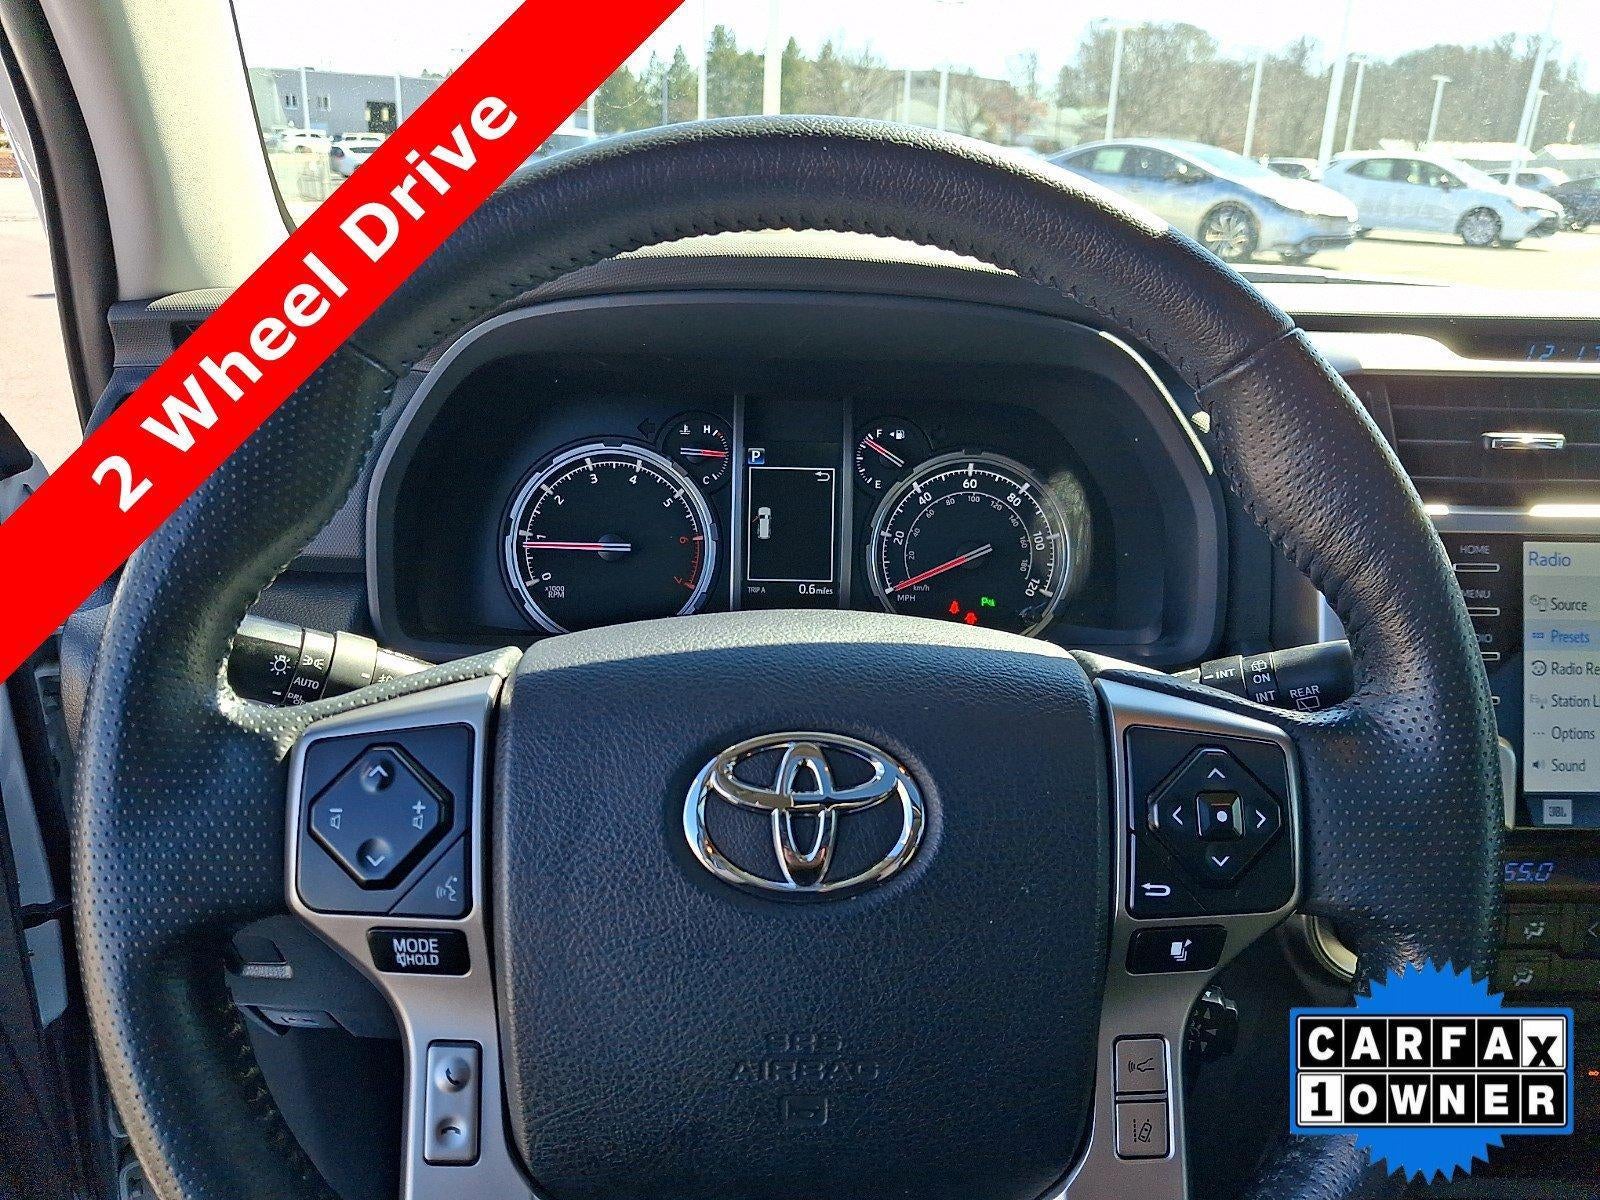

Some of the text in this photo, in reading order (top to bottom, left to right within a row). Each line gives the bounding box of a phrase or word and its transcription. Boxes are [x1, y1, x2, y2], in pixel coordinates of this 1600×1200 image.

[703, 424, 711, 434] H
[876, 429, 883, 438] F
[590, 474, 598, 484] 3
[628, 475, 637, 485] 4
[702, 475, 710, 485] C
[875, 480, 882, 489] E
[962, 478, 978, 489] 60
[554, 495, 565, 506] 2
[663, 498, 673, 508] 5
[918, 491, 933, 506] 40
[967, 494, 981, 504] 100
[1006, 492, 1022, 508] 80
[990, 500, 1003, 511] 120
[893, 530, 905, 546] 20
[912, 527, 921, 538] 40
[1033, 530, 1045, 551] 100
[908, 550, 915, 560] 20
[1459, 544, 1490, 555] HOME
[1528, 550, 1572, 567] Radio
[541, 572, 552, 581] 0
[913, 584, 930, 592] km/h
[1025, 578, 1041, 598] 120
[897, 594, 916, 602] MPH
[1550, 597, 1587, 612] Source
[1551, 629, 1590, 644] Presets
[1216, 668, 1236, 679] INT
[1551, 661, 1583, 676] Radio
[293, 677, 320, 690] AUTO
[1253, 672, 1271, 684] ON
[1255, 690, 1276, 703] INT
[1289, 685, 1321, 698] REAR
[1551, 693, 1590, 709] Station
[1551, 725, 1595, 743] Options
[1551, 758, 1586, 773] Sound
[392, 938, 440, 954] MODE
[407, 954, 440, 967] HOLD
